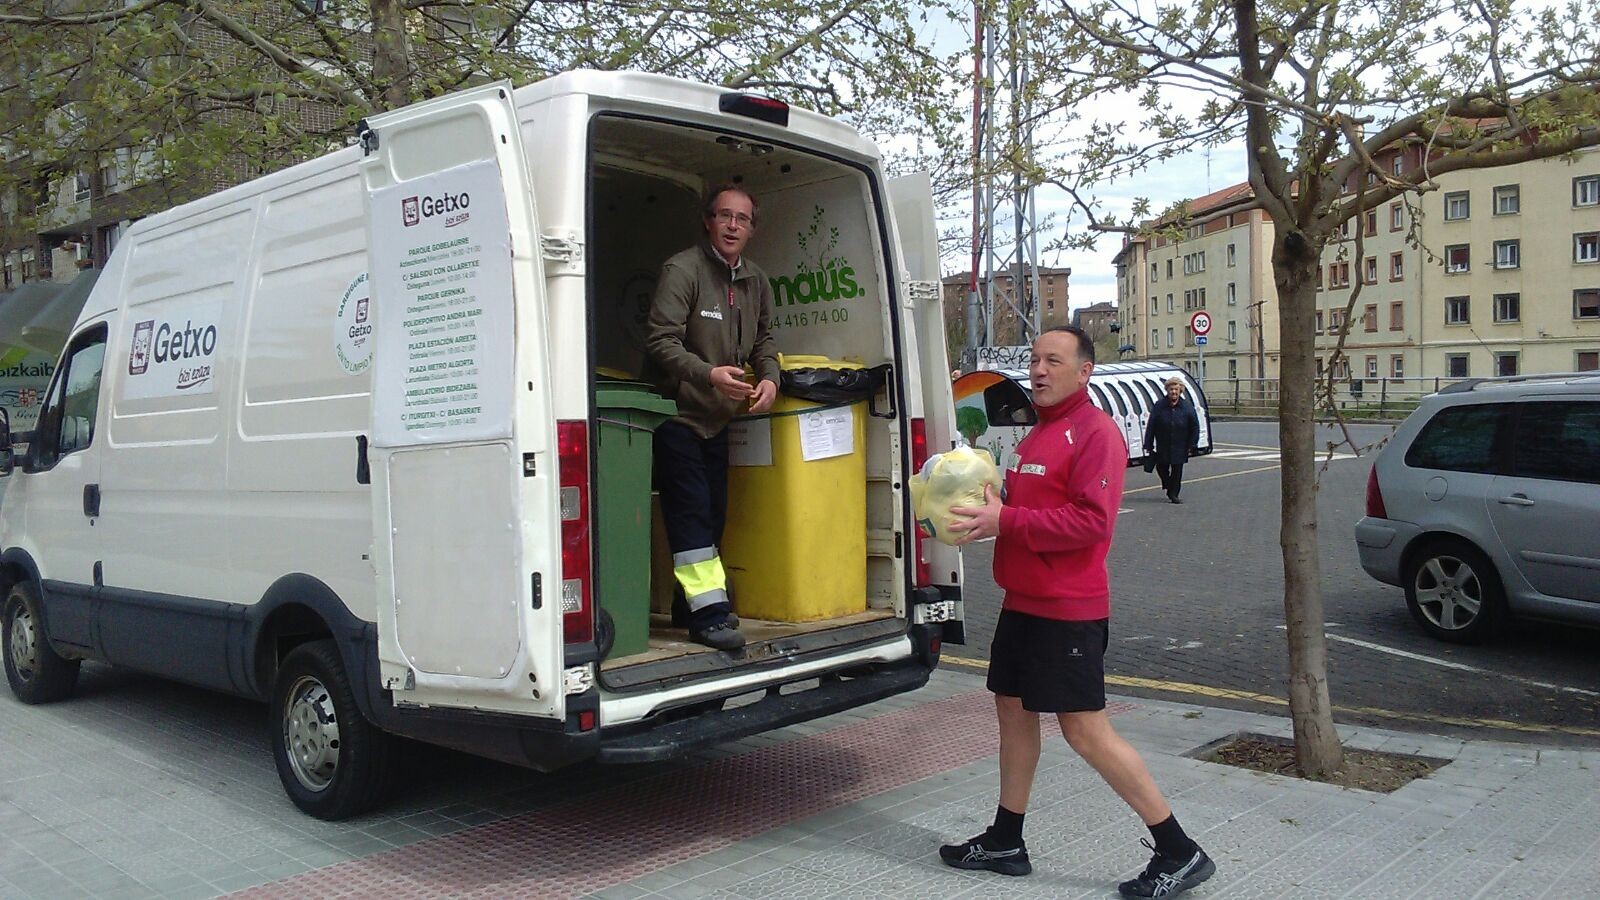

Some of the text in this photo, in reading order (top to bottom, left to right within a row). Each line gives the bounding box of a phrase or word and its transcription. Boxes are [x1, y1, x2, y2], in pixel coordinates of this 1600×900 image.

[421, 192, 470, 218] Getxo
[408, 245, 431, 256] PARQUE
[433, 267, 446, 276] CON
[416, 293, 440, 303] PARQUE
[785, 312, 808, 328] 416
[811, 310, 828, 325] 74
[831, 307, 849, 323] 00
[1196, 319, 1208, 328] 30
[348, 324, 372, 339] Getxo
[153, 320, 217, 363] Getxo
[408, 341, 426, 351] PLAZA
[409, 359, 475, 374] PLAZA METRO ALGORTA
[447, 406, 482, 417] BASARRATE
